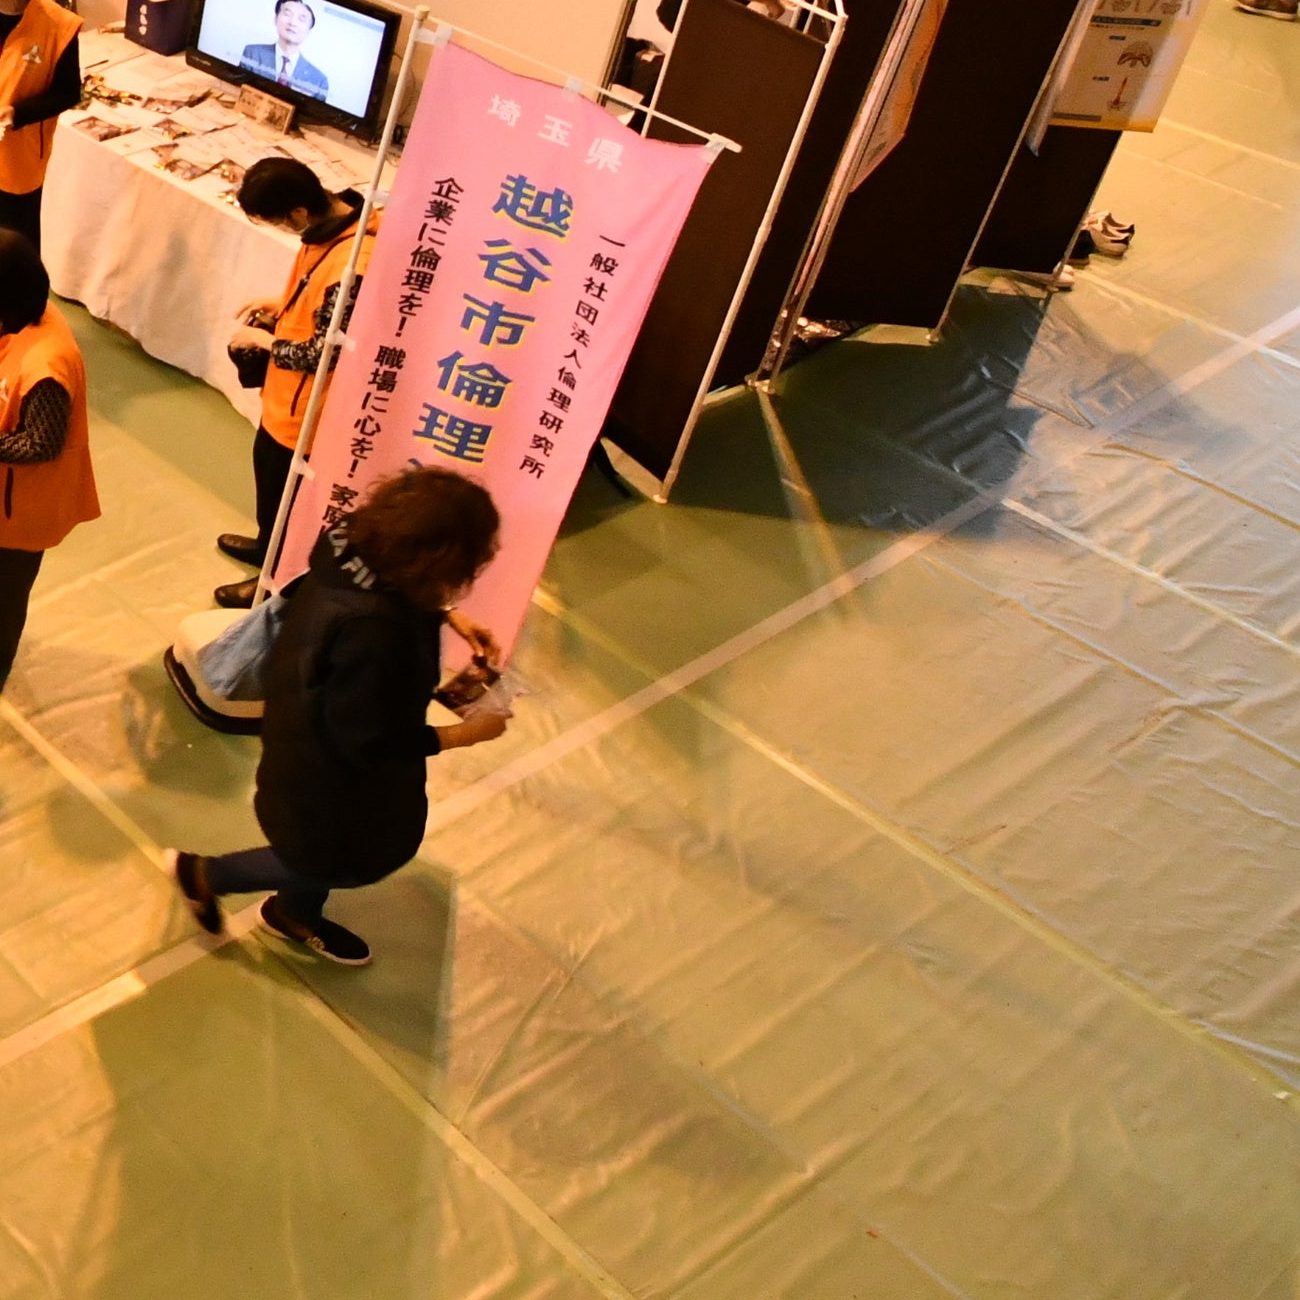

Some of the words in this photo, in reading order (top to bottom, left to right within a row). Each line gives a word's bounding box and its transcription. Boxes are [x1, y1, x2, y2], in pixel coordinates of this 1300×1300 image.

[487, 93, 626, 174] 埼玉県
[406, 172, 575, 469] 越谷市倫理
[519, 233, 626, 480] 一般社団法人倫理研究所
